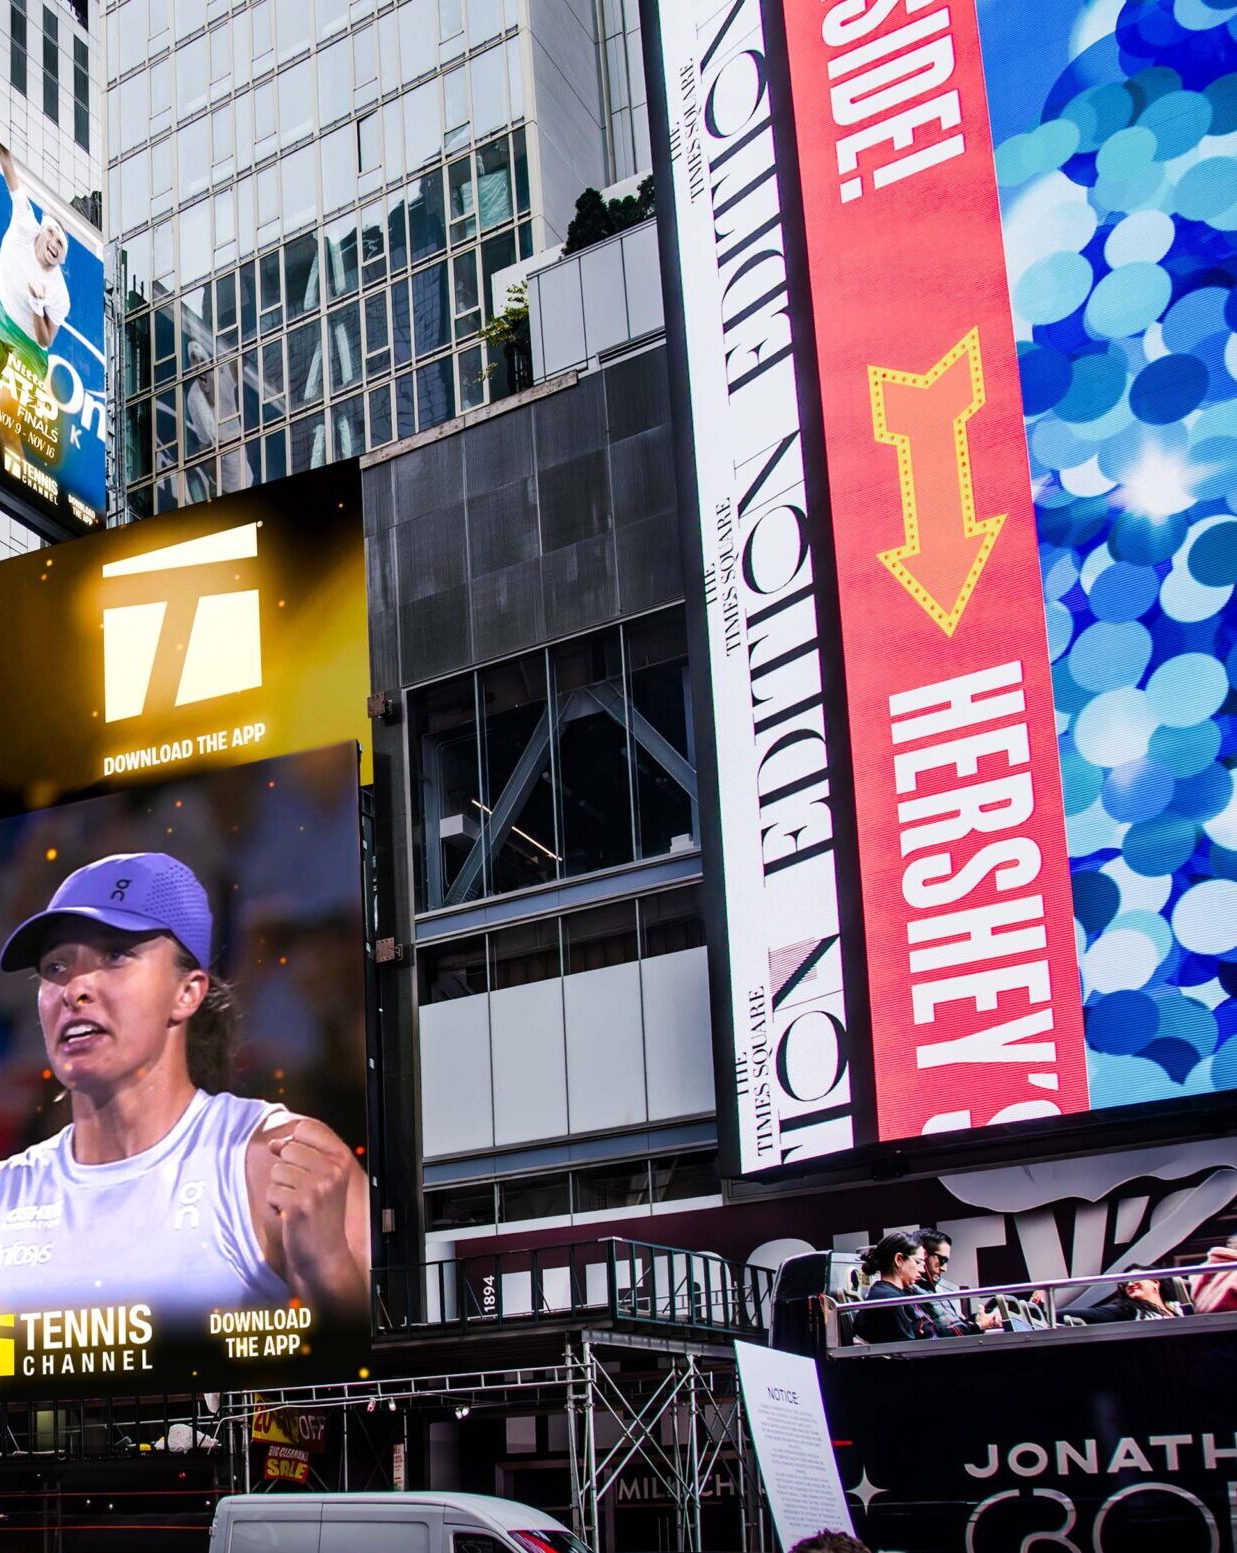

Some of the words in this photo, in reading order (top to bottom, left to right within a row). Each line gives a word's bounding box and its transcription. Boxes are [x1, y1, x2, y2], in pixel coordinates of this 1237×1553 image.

[8, 352, 46, 390] Nitto
[14, 423, 22, 436] 9
[27, 433, 46, 451] NOV
[46, 444, 56, 460] 16
[17, 406, 59, 444] FINALS
[22, 459, 59, 496] TENNIS
[22, 475, 59, 506] CHANNEL
[733, 430, 834, 888] EDITION
[103, 740, 194, 777] DOWNLOAD
[197, 731, 228, 755] THE
[231, 722, 266, 746] APP
[748, 986, 773, 1081] SQUARE
[735, 1051, 750, 1096] THE
[754, 1083, 773, 1158] TIMES
[483, 1275, 495, 1312] 1894
[21, 1304, 153, 1350] TENNIS
[209, 1307, 312, 1335] DOWNLOAD
[23, 1350, 153, 1377] CHANNEL
[226, 1337, 259, 1359] THE
[263, 1335, 301, 1356] APP
[767, 1387, 800, 1405] NOTICE
[298, 1414, 326, 1440] OFF
[266, 1457, 308, 1479] SALE
